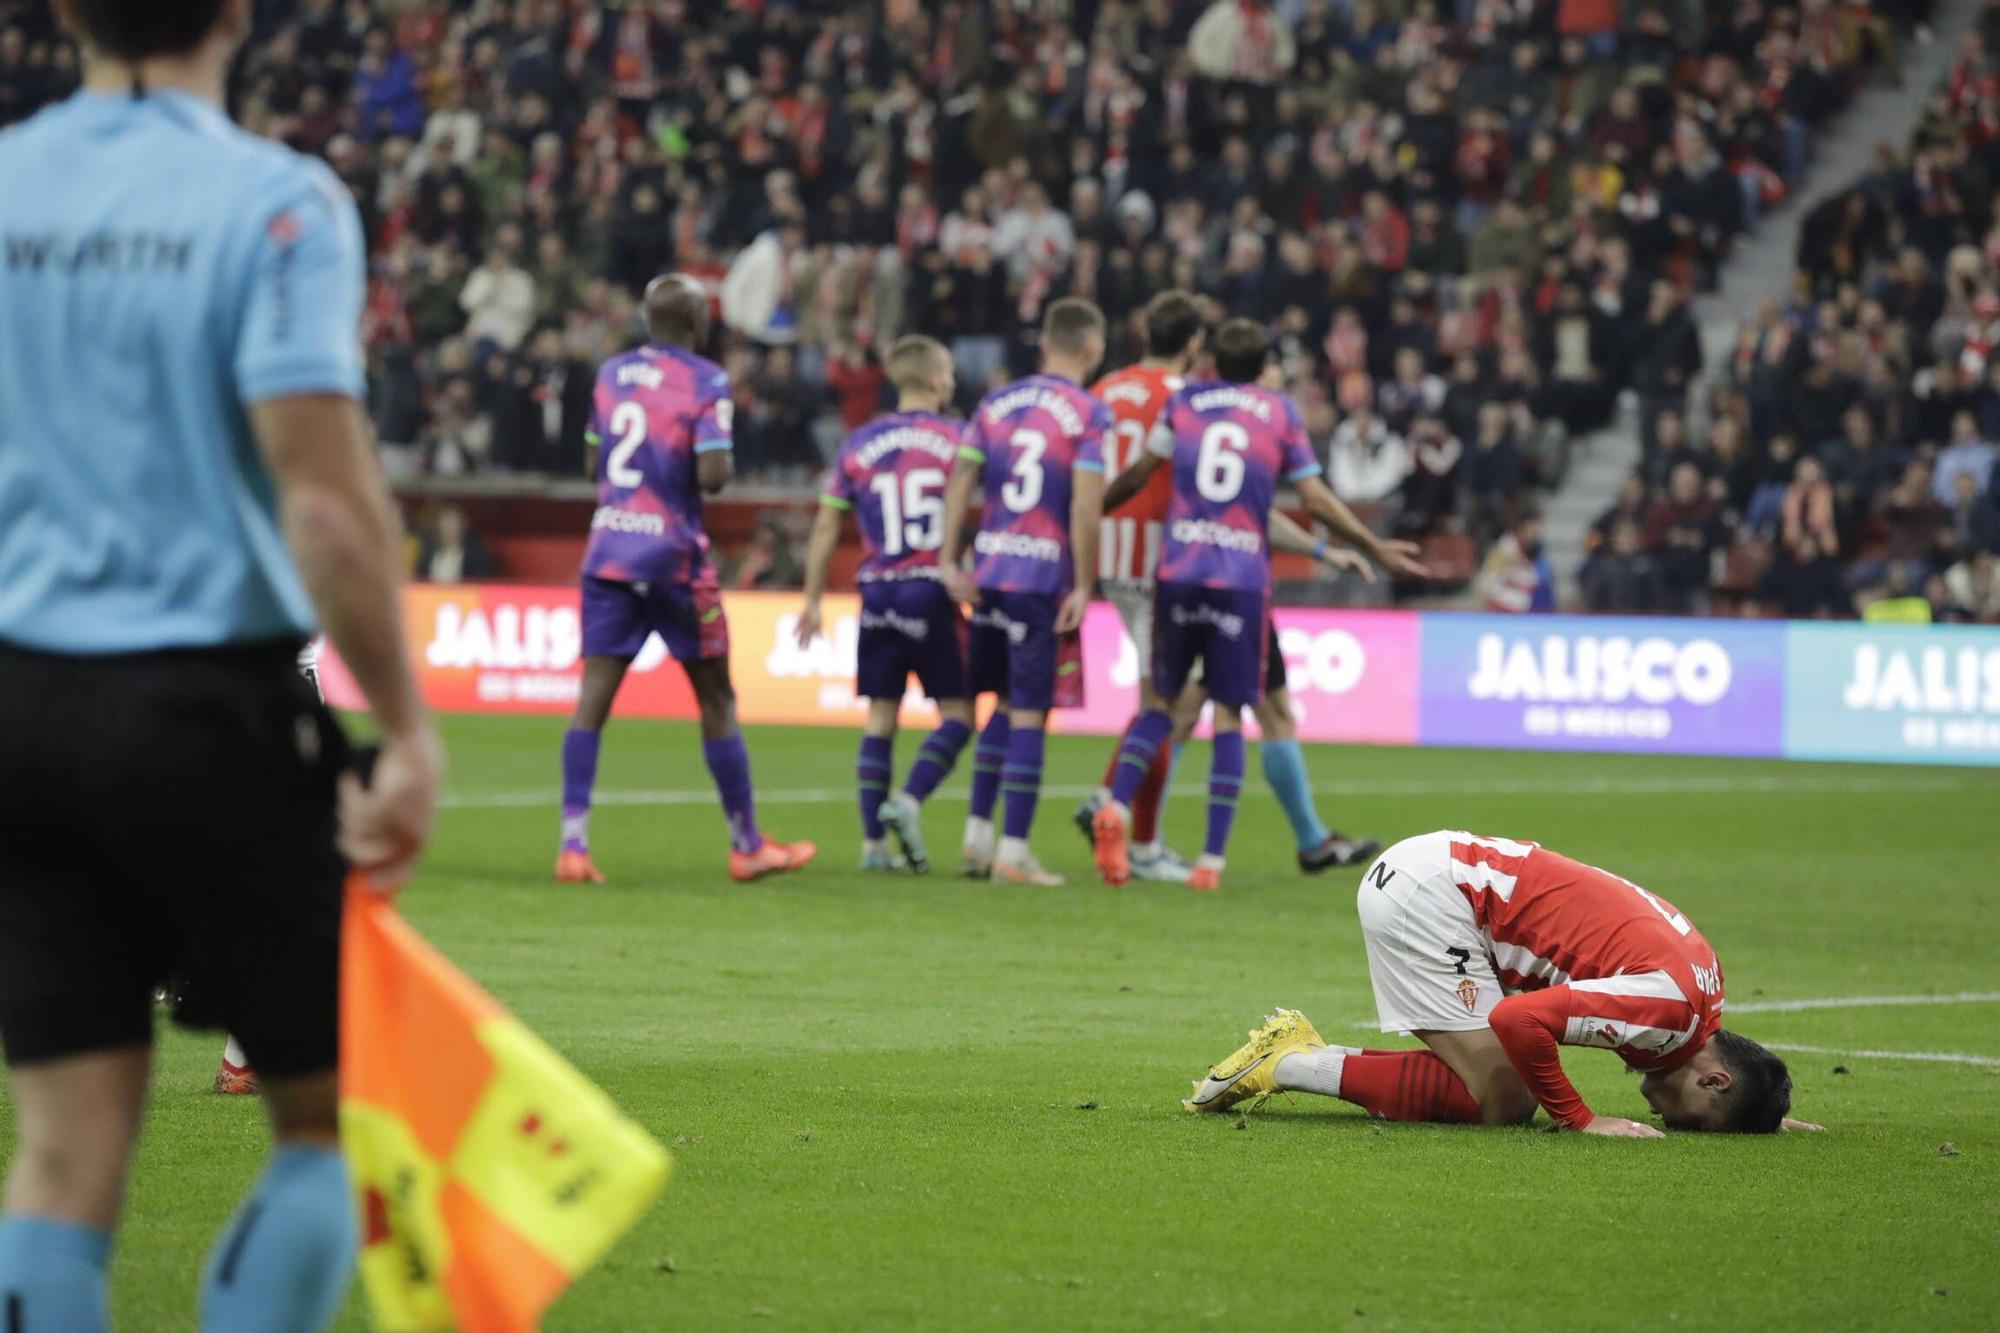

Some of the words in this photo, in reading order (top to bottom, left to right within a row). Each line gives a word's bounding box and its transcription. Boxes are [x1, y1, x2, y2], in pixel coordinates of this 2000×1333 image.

[606, 401, 647, 489] 2
[1001, 428, 1047, 512] 3
[1196, 421, 1249, 502] 6
[870, 468, 947, 555] 15
[1467, 634, 1732, 706] JALISCO
